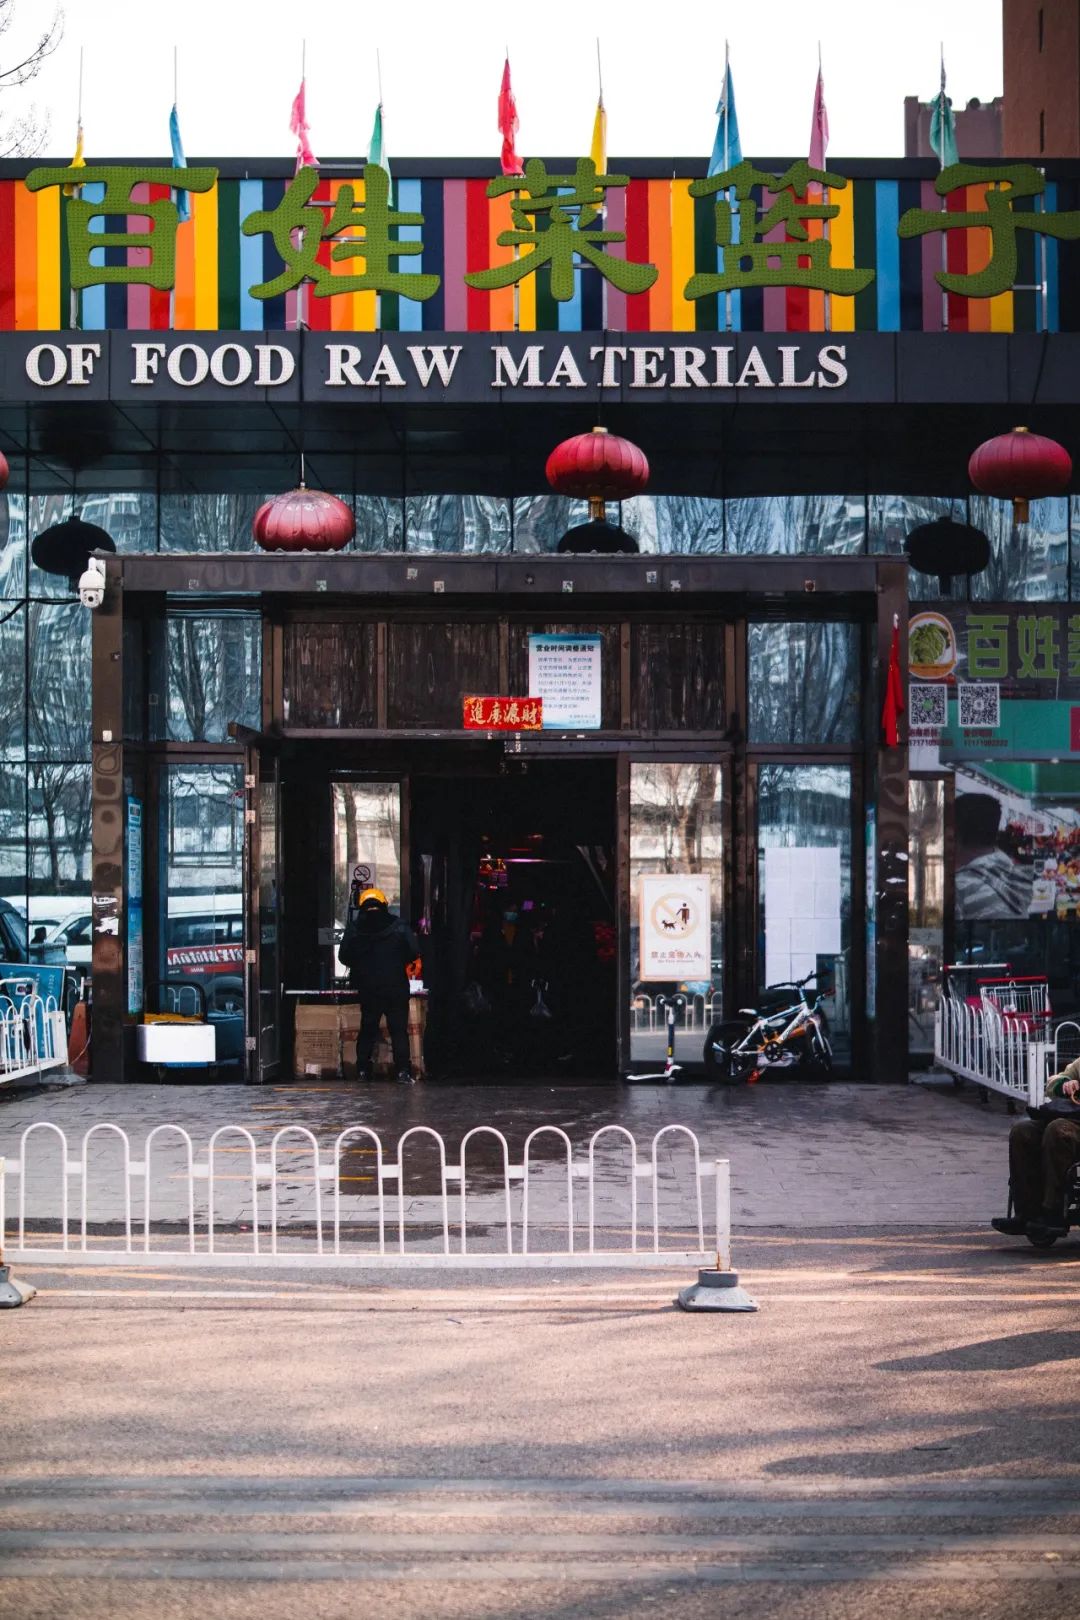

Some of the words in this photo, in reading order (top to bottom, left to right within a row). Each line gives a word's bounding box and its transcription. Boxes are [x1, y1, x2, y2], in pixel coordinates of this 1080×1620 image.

[25, 158, 1080, 301] 百姓菜篮子
[26, 344, 100, 385] OF
[131, 344, 294, 385] FOOD
[325, 345, 462, 386] RAW
[491, 346, 847, 387] MATERIALS
